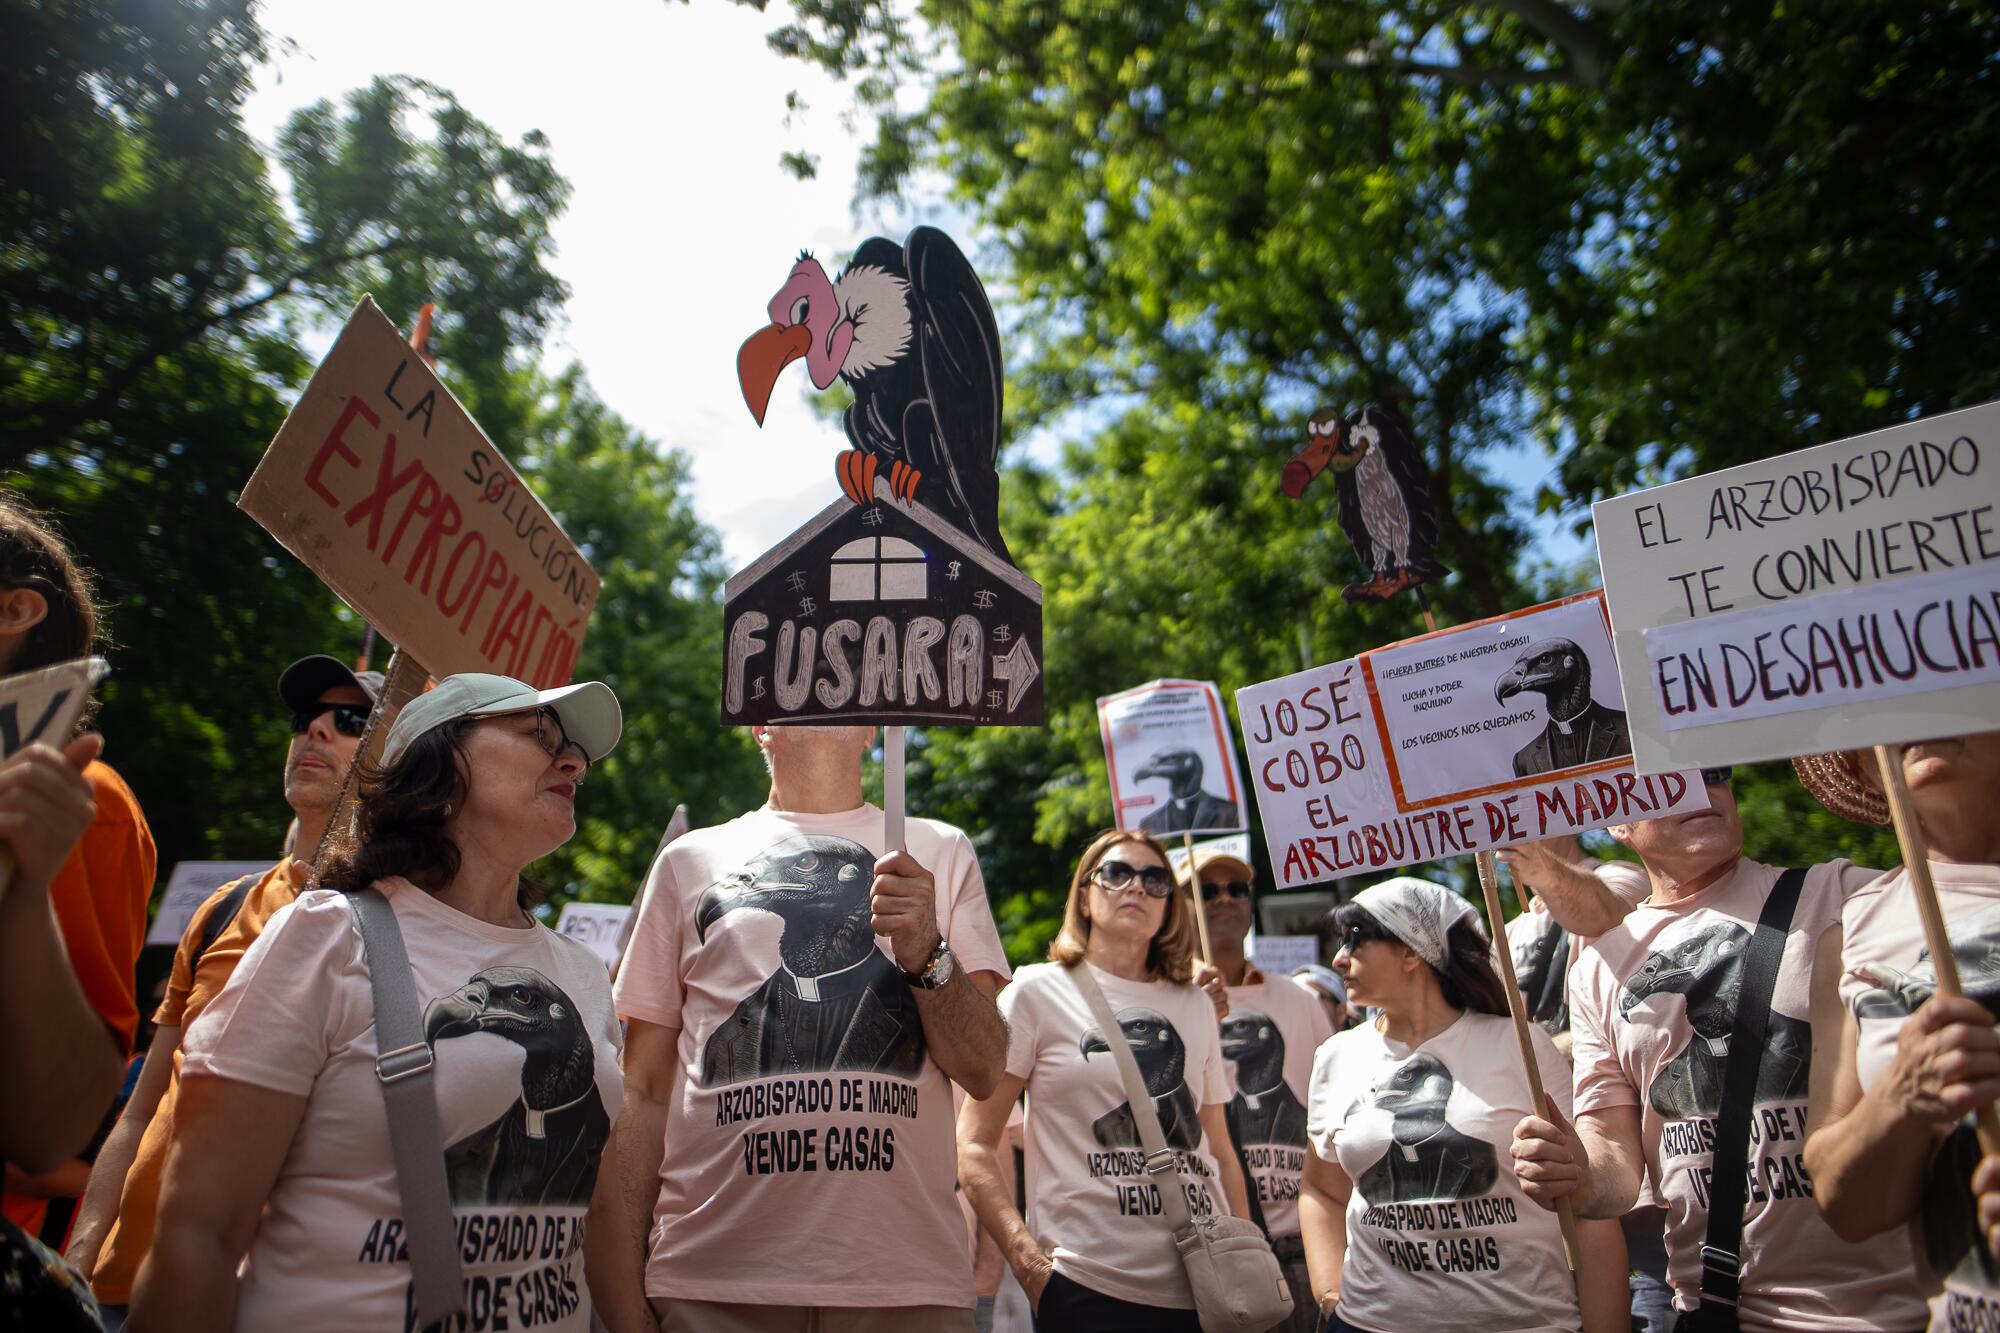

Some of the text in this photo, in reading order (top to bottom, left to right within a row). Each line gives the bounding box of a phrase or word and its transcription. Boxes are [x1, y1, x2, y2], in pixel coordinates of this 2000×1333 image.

[383, 359, 436, 439] LA
[1634, 435, 1980, 549] EL ARZOBISPADO
[463, 449, 591, 609] SOLUCIÓN:
[1668, 504, 2000, 617] TE CONVIERTE
[725, 610, 985, 716] FUSARA
[1414, 655, 1446, 672] BUITRES
[1447, 654, 1458, 664] DE
[1460, 644, 1498, 661] NUESTRAS
[1656, 590, 2000, 717] EN DESAHUCIA
[1253, 665, 1361, 744] JOSÉ
[1401, 680, 1463, 703] LUCHA Y PODER
[1413, 696, 1452, 713] INQUILINO
[1401, 709, 1536, 750] LOS VECINOS NOS QUEDAMOS
[1262, 733, 1366, 792] COBO
[1284, 771, 1687, 883] ARZOBUITRE DE MADRID
[1306, 794, 1348, 829] EL
[716, 1078, 918, 1127] ARZOBISPADO DE MADRID
[1761, 1107, 1796, 1141] DE
[742, 1126, 895, 1176] VENDE CASAS
[1116, 1183, 1167, 1216] VEND
[1763, 1153, 1813, 1200] CAS
[1437, 1203, 1461, 1229] DE
[1463, 1197, 1518, 1228] MADRID
[540, 1216, 566, 1260] DE
[1435, 1236, 1500, 1273] CASAS
